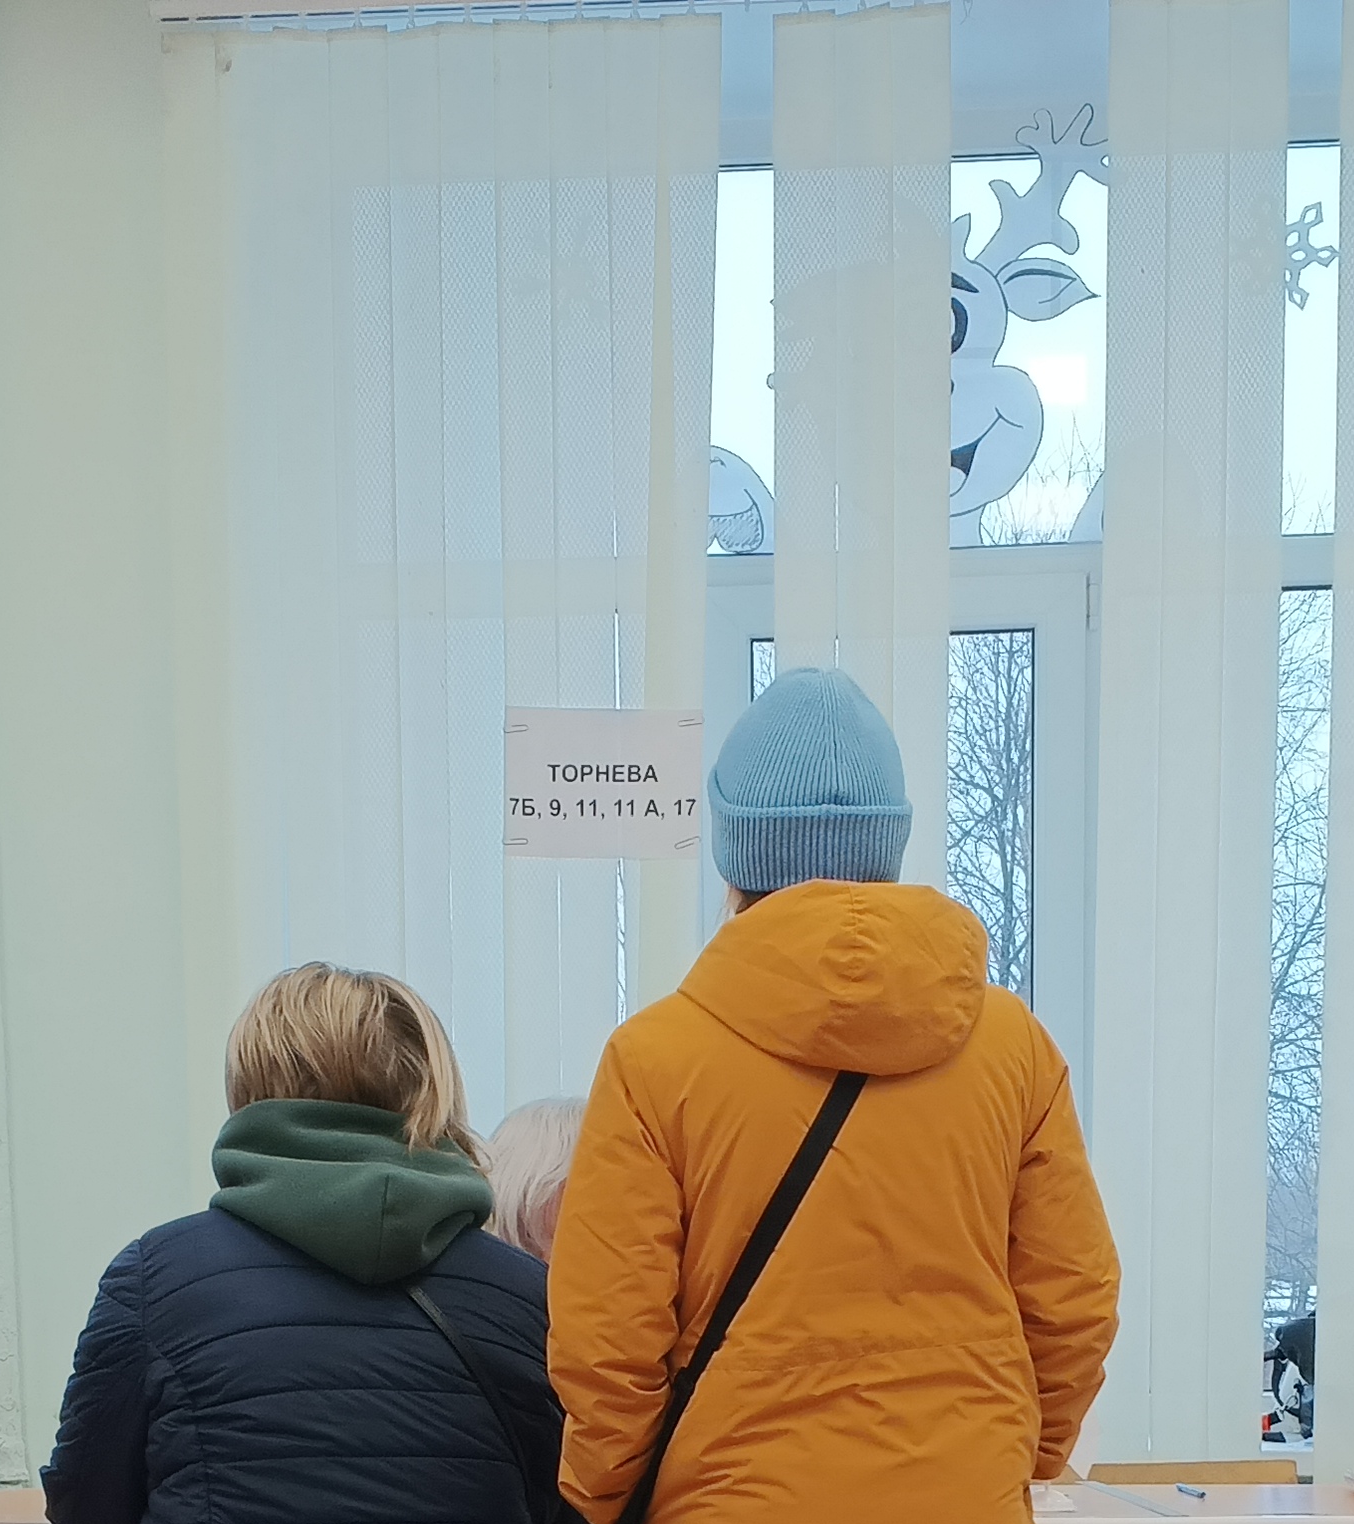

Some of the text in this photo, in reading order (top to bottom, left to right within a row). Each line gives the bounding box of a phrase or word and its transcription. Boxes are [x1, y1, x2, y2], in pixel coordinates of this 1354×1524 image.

[547, 765, 659, 782] ТОРНЕВА
[509, 798, 696, 819] 7Б, 9, 11, 11 А, 17
